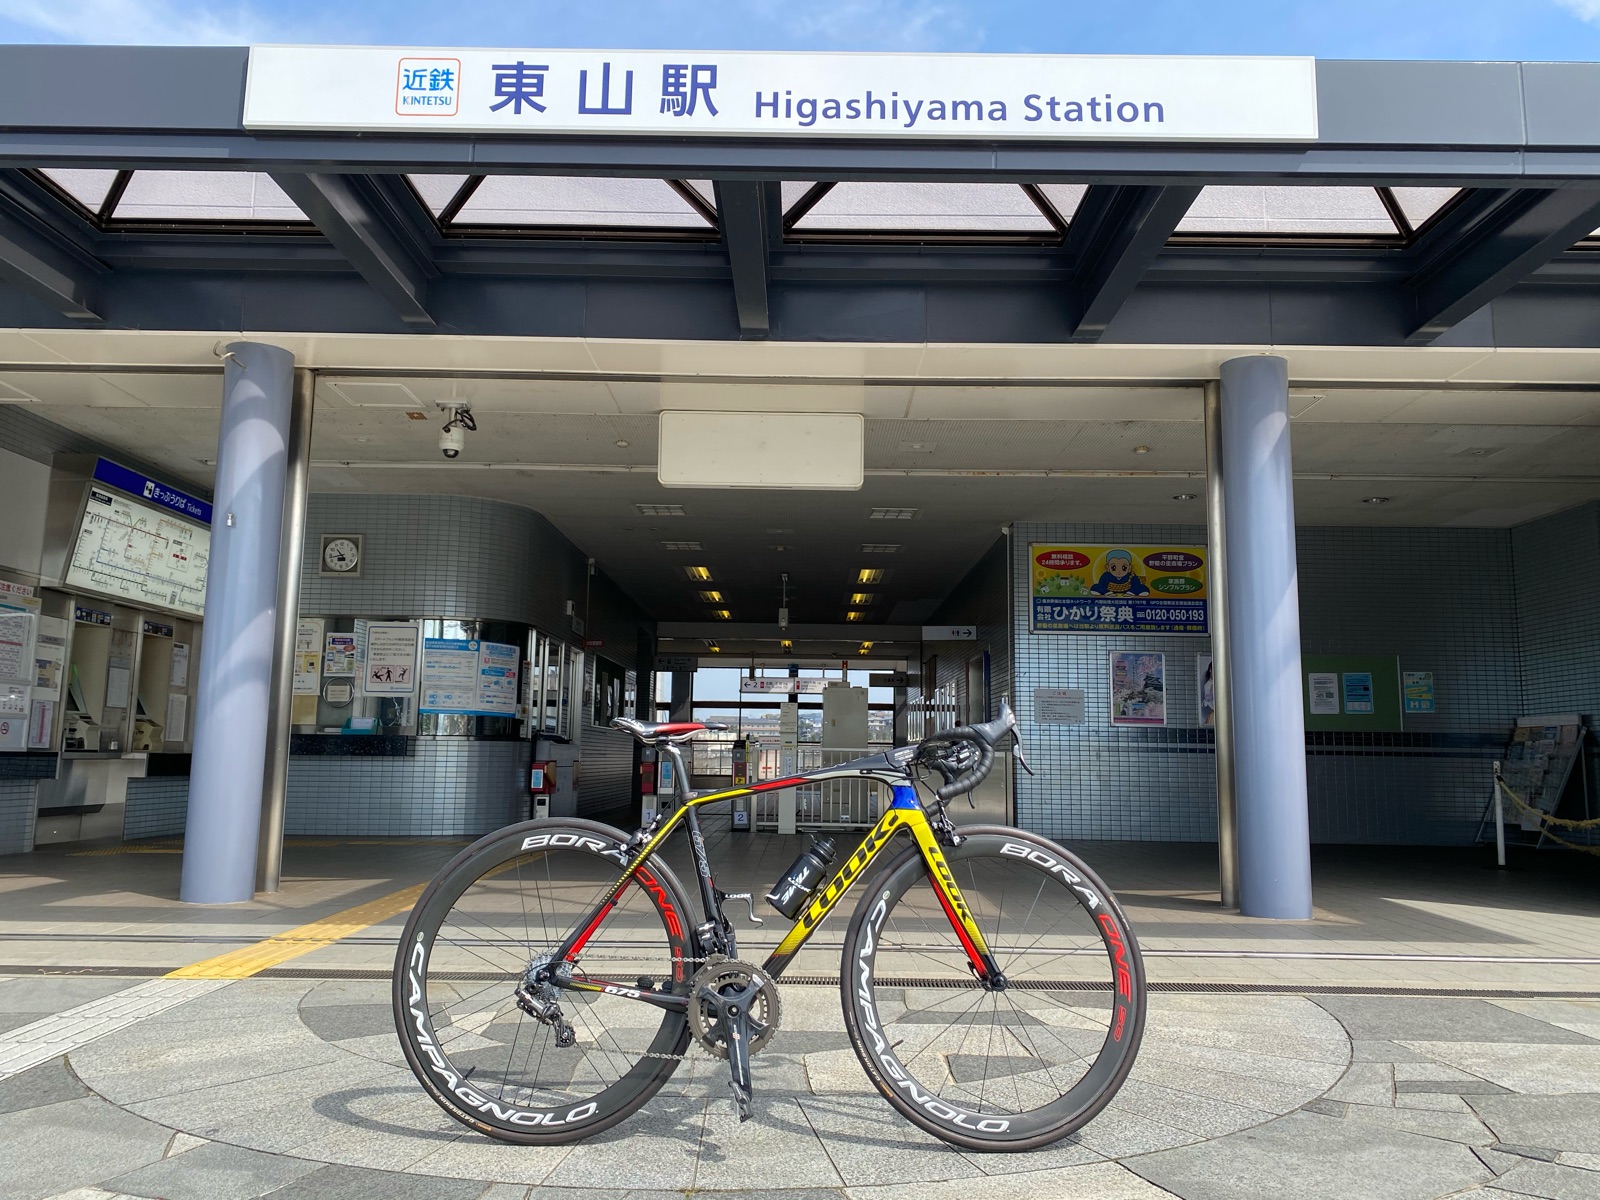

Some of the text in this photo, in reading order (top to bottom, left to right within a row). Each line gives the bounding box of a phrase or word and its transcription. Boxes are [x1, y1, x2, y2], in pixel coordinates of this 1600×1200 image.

[402, 67, 455, 92] 近鉄
[488, 60, 719, 117] 東山駅
[402, 95, 452, 106] KINTETSU
[754, 90, 1165, 127] Higashiyama Station
[153, 487, 187, 509] きっぷうりば
[186, 502, 202, 516] Tickets
[1052, 605, 1135, 623] ひかり祭典
[1145, 609, 1205, 621] 0120-050-193
[737, 813, 744, 822] 2
[802, 815, 894, 930] LOOK
[928, 845, 975, 924] LOOK
[634, 864, 685, 942] ONE
[999, 841, 1100, 910] BORA
[1097, 912, 1133, 1004] ONE
[604, 985, 641, 998] 675
[409, 941, 598, 1126] CAMPAGNOLO
[858, 899, 1010, 1133] CAMPAGNOLO
